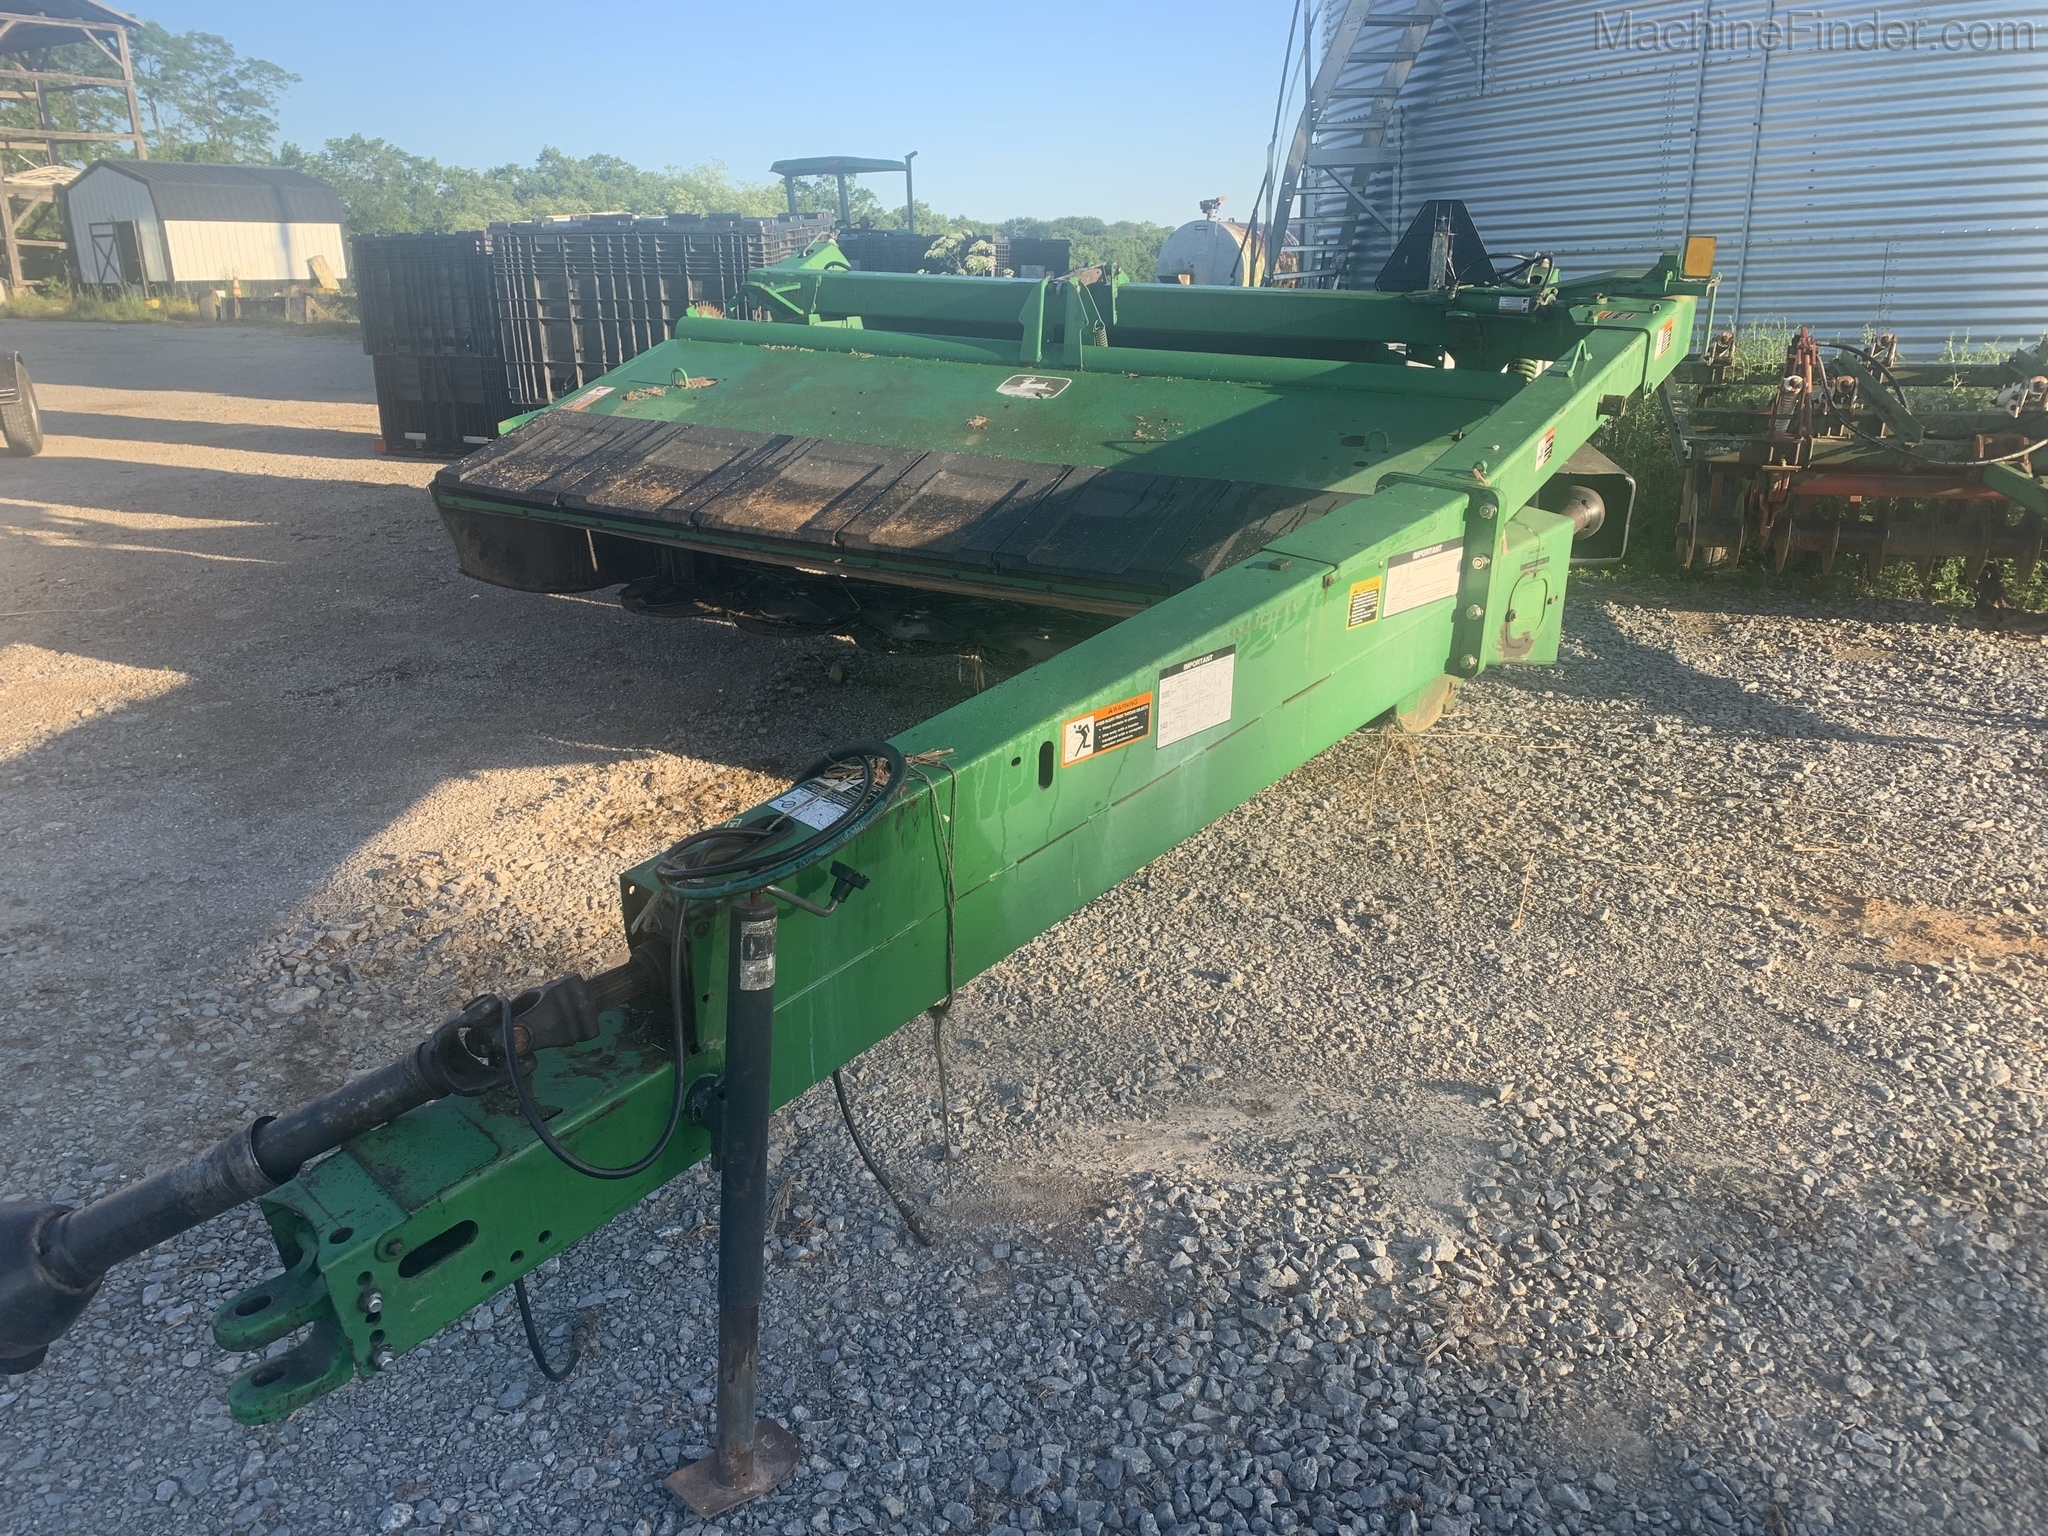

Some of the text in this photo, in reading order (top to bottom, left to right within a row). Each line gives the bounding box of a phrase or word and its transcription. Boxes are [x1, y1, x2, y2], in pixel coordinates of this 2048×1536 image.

[1412, 544, 1443, 560] IMPORTANT
[1183, 654, 1214, 670] IMPORTANT
[1113, 699, 1138, 712] WARNING
